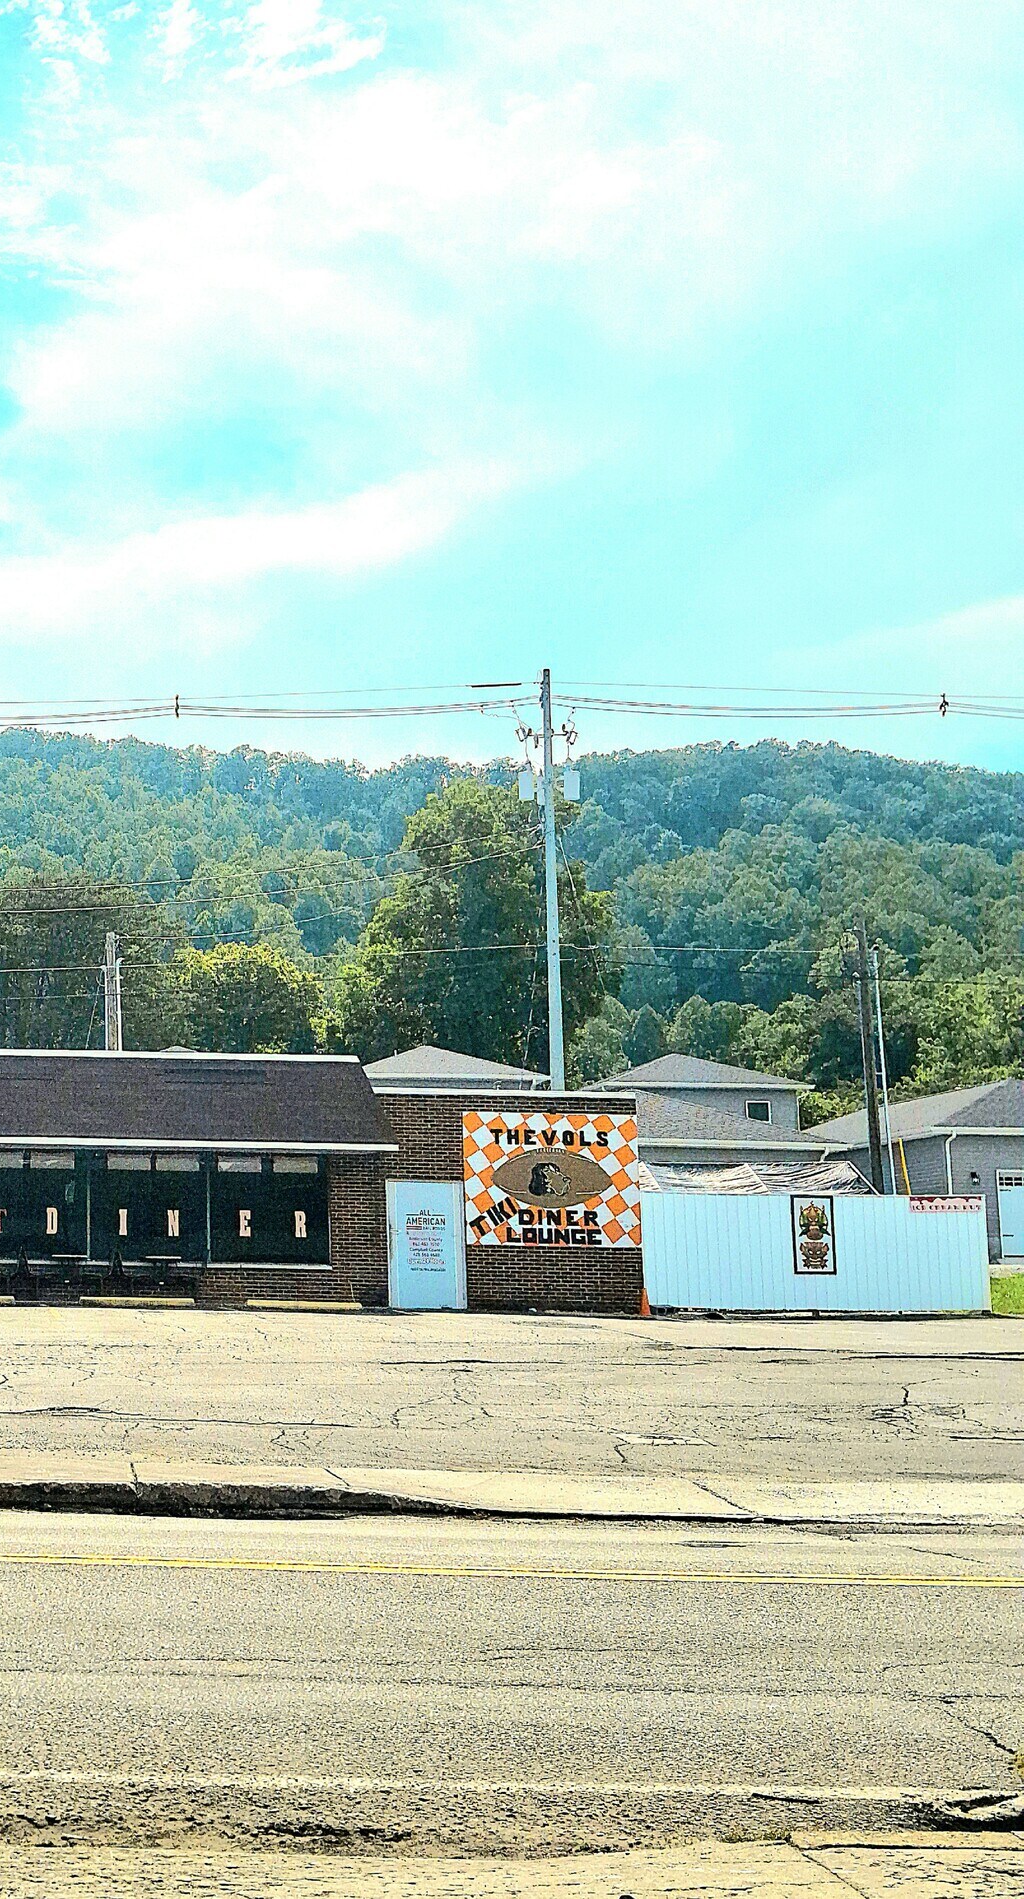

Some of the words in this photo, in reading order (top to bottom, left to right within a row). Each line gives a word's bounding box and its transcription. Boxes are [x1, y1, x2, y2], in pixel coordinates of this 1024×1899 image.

[419, 1209, 432, 1217] ALL
[469, 1196, 517, 1237] TIKI
[518, 1209, 600, 1227] DINER
[406, 1217, 446, 1226] AMERICAN
[506, 1227, 602, 1245] LOUNGE
